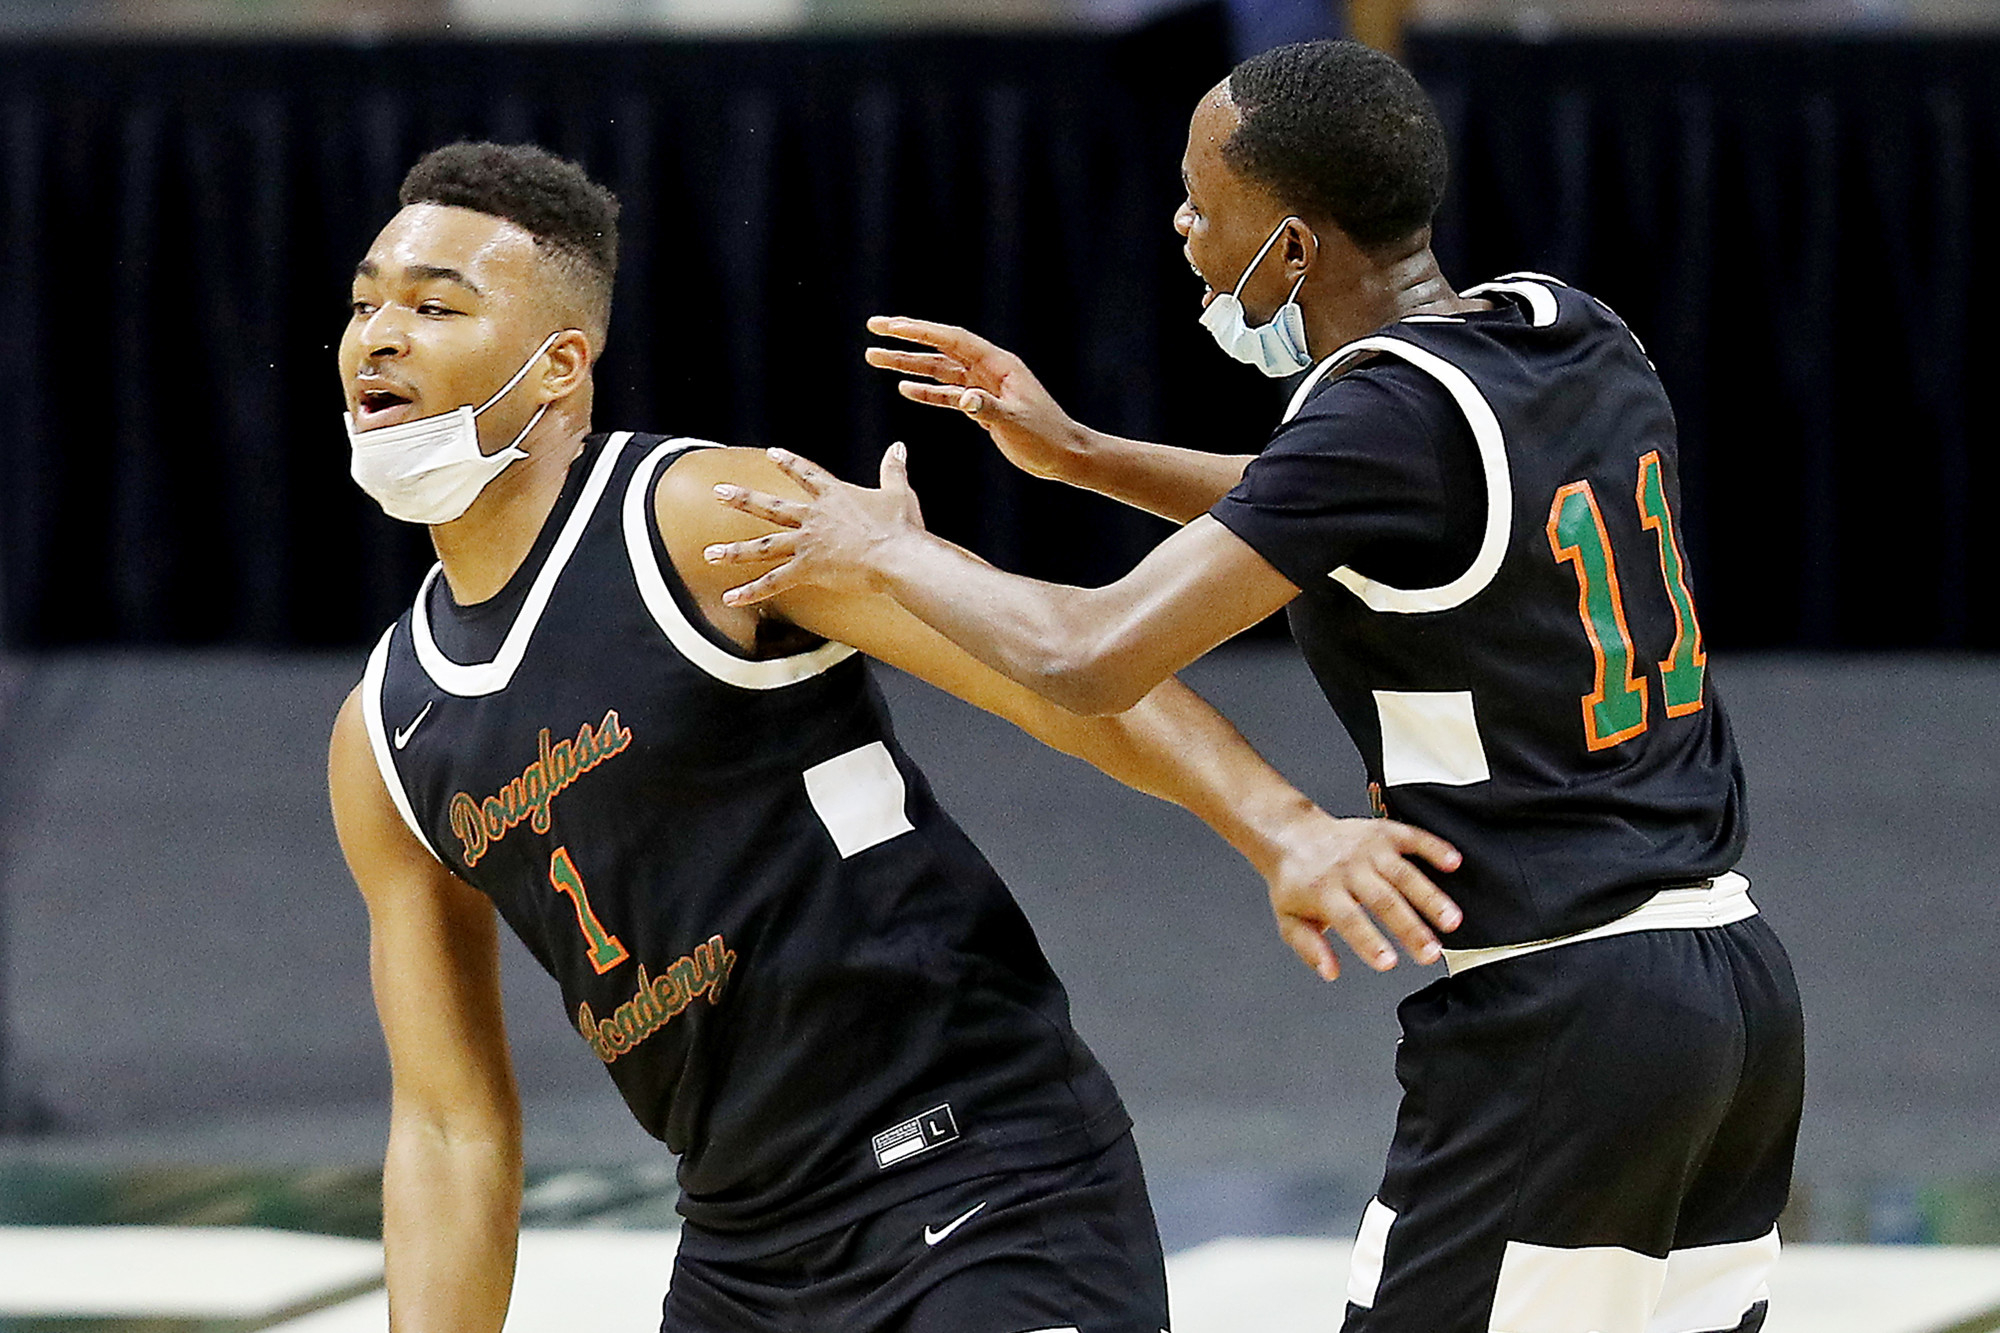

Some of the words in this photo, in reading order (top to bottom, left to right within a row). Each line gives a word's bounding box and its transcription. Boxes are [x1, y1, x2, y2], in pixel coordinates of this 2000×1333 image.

[1546, 450, 1706, 752] 11
[450, 709, 632, 867] Douglass
[549, 846, 630, 975] 1
[929, 1120, 946, 1137] L
